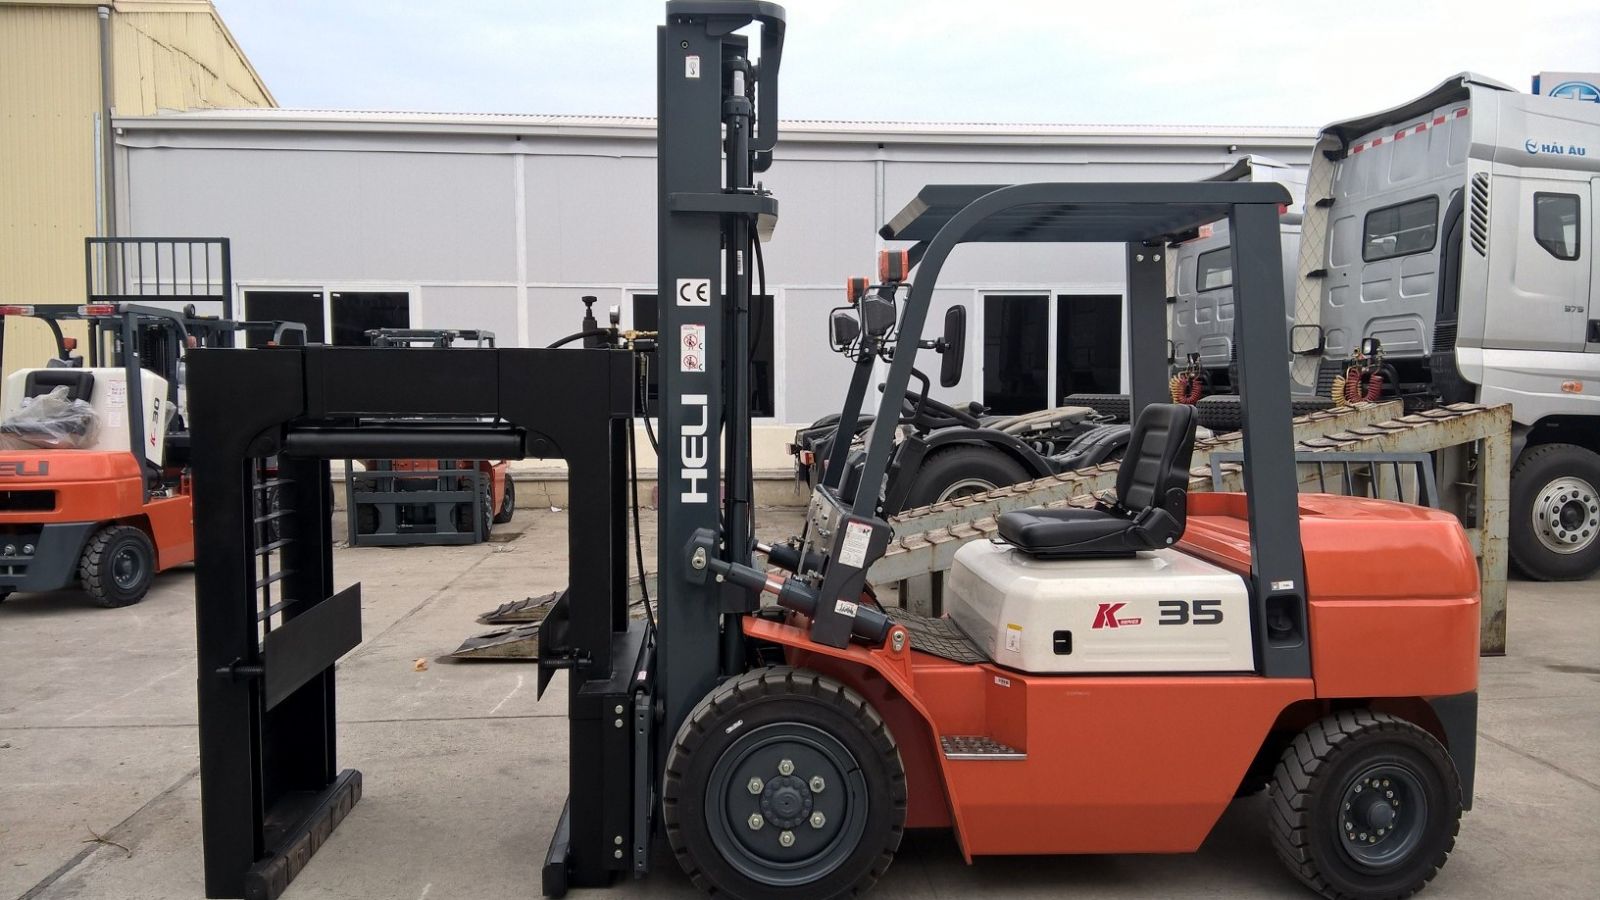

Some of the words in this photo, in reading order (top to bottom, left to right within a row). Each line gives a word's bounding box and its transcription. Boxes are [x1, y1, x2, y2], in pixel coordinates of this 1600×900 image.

[680, 282, 707, 302] CE
[681, 394, 708, 503] HELI
[1092, 602, 1127, 629] K
[1158, 599, 1223, 625] 35
